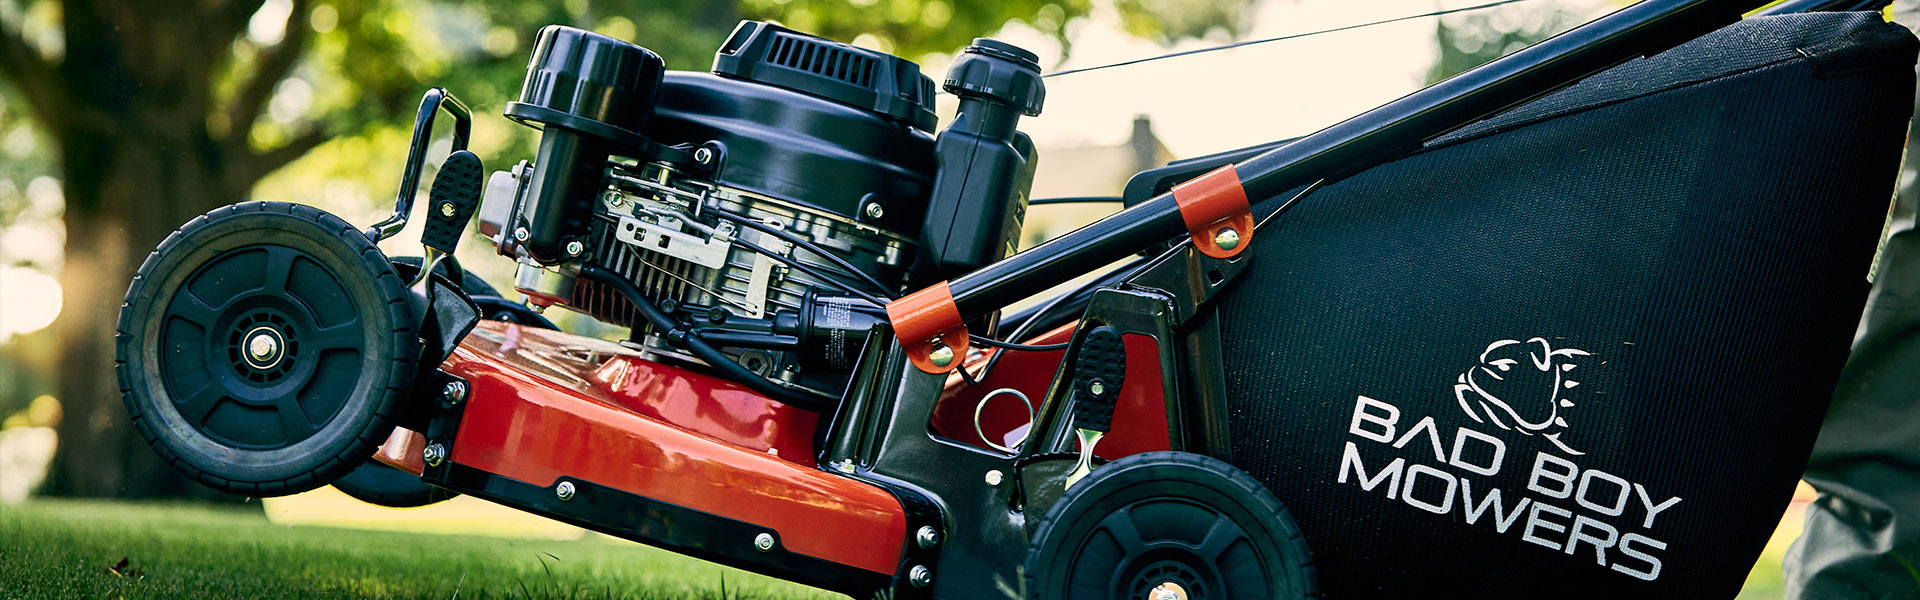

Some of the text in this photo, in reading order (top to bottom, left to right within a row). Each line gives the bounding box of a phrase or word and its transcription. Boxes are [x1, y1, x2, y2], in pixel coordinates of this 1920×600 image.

[1338, 441, 1668, 581] MOWERS
[1349, 395, 1682, 529] BAD BOY
